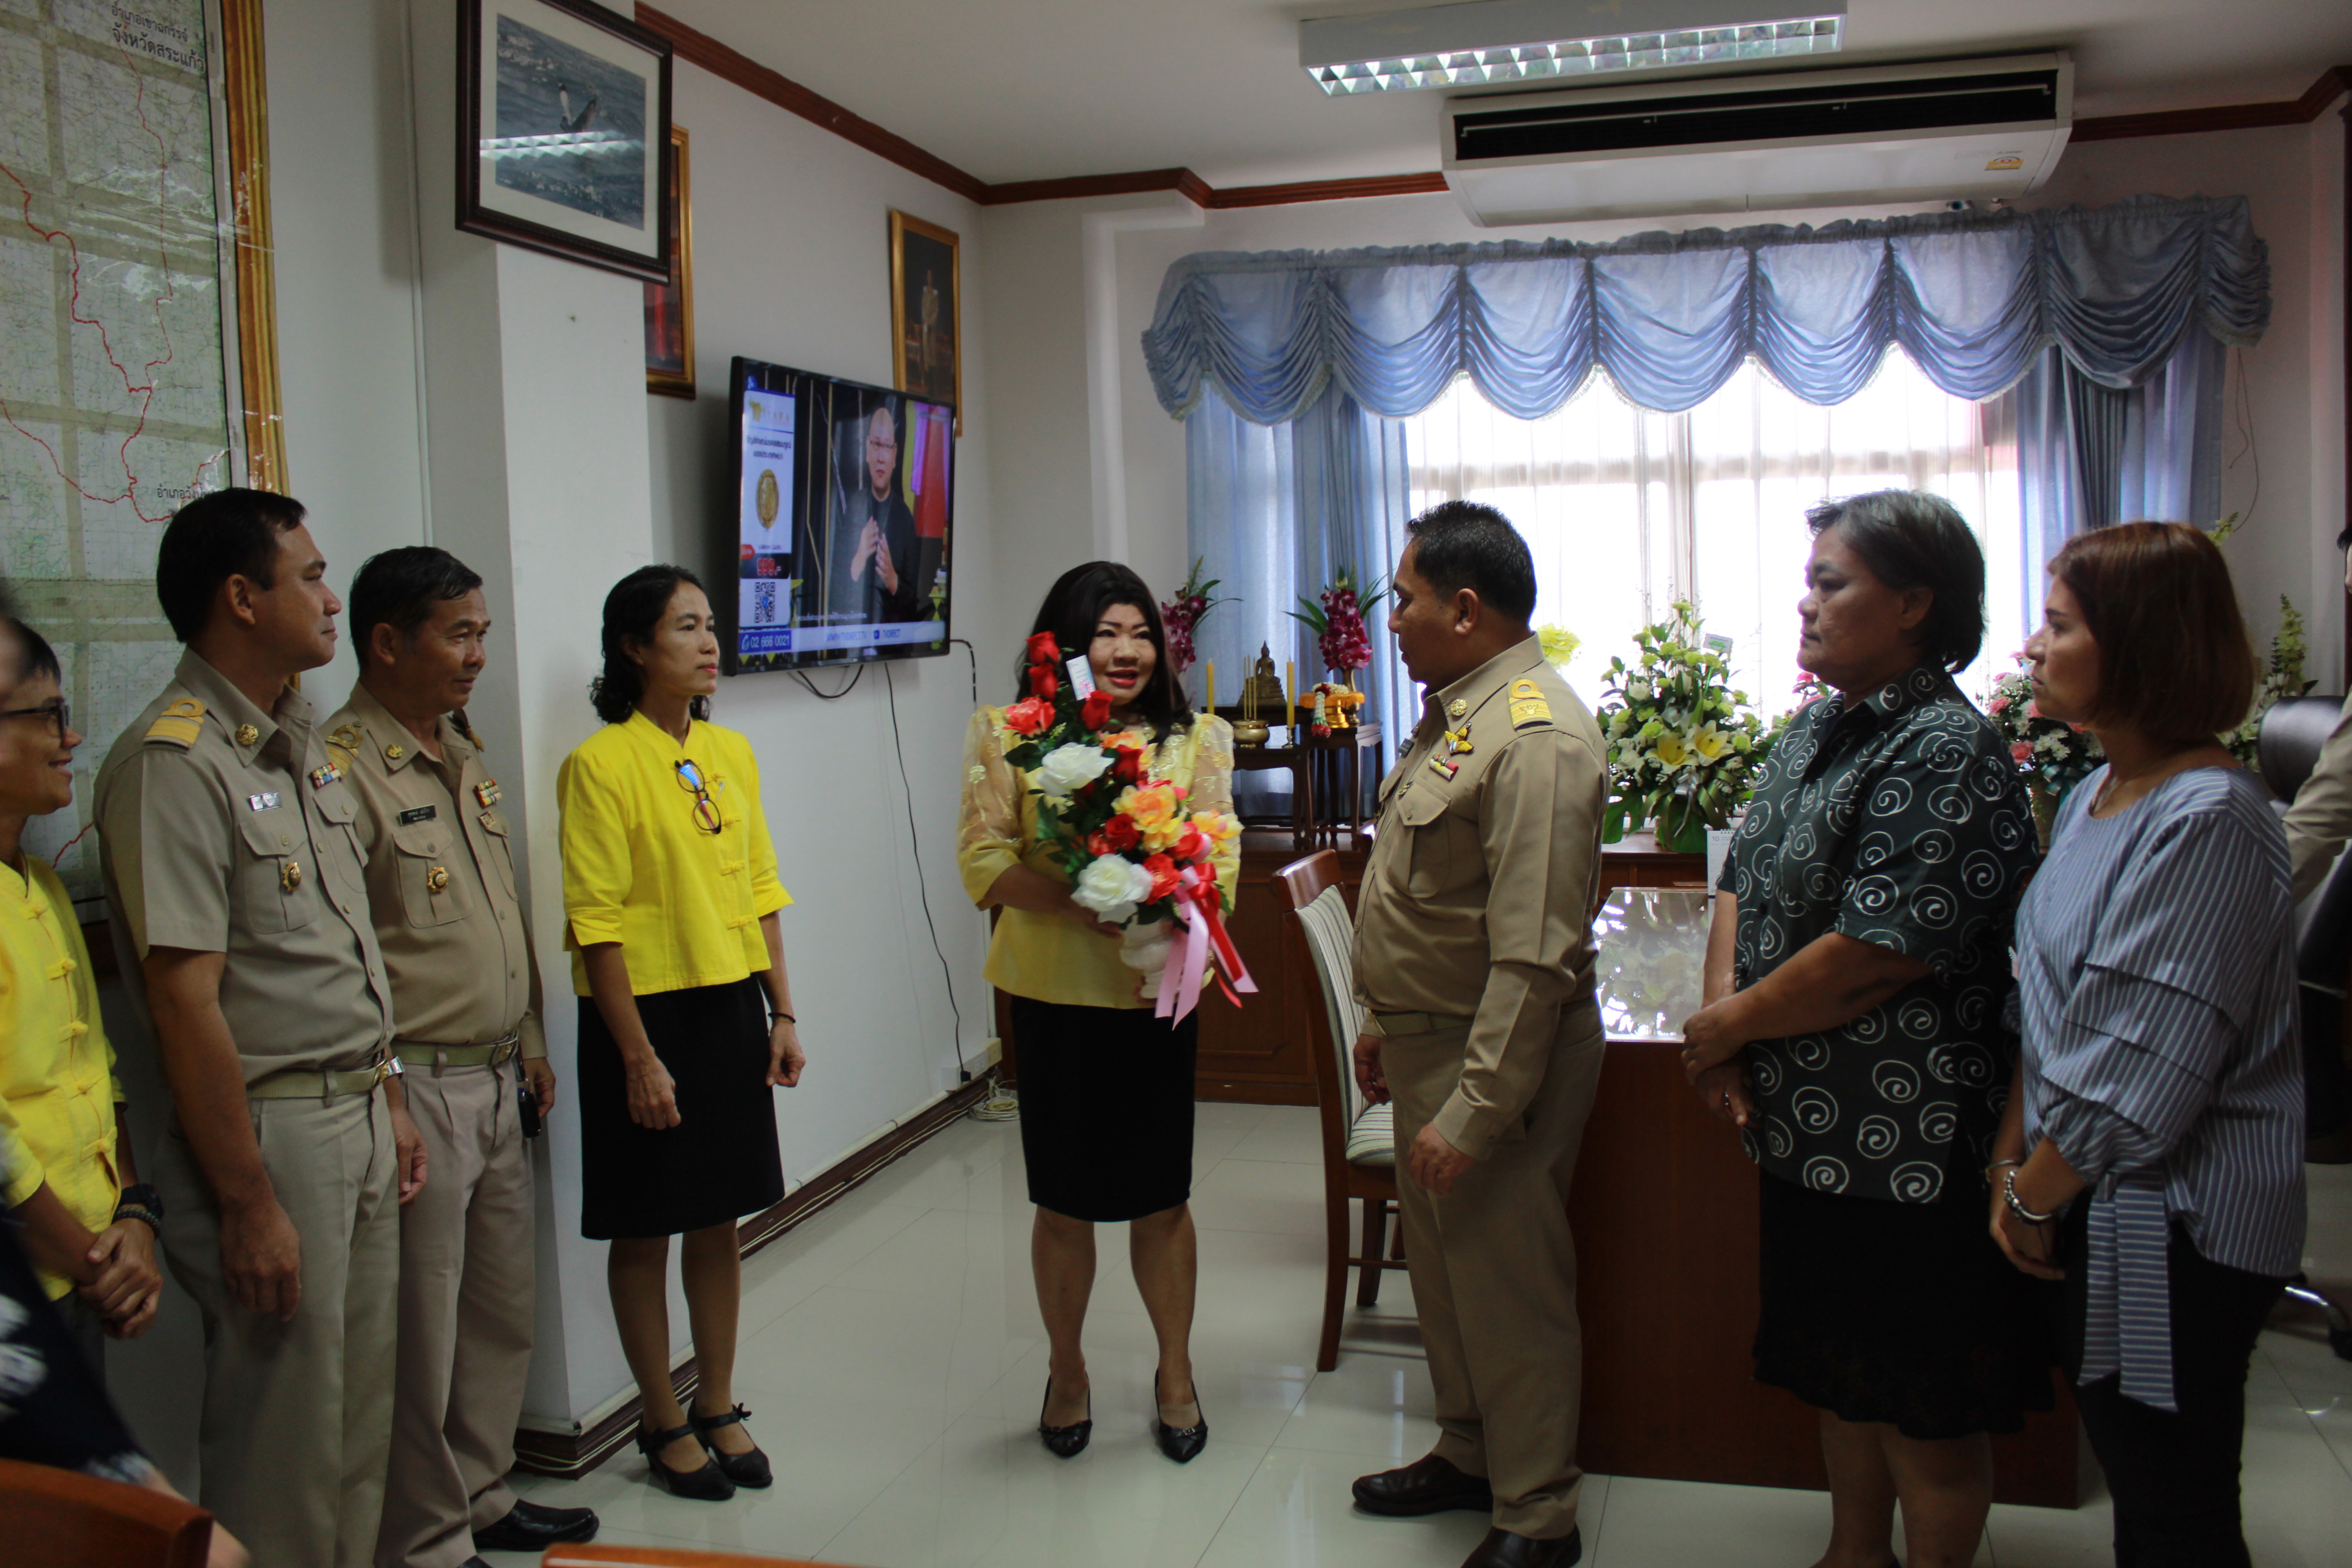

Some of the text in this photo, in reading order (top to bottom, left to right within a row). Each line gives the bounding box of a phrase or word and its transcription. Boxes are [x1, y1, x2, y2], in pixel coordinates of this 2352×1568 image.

[112, 1, 188, 42] อำเภอเขาฉกรรจ์
[112, 22, 204, 72] จังหวัดสระแก้ว
[750, 636, 759, 648] 02
[774, 634, 789, 646] 0021
